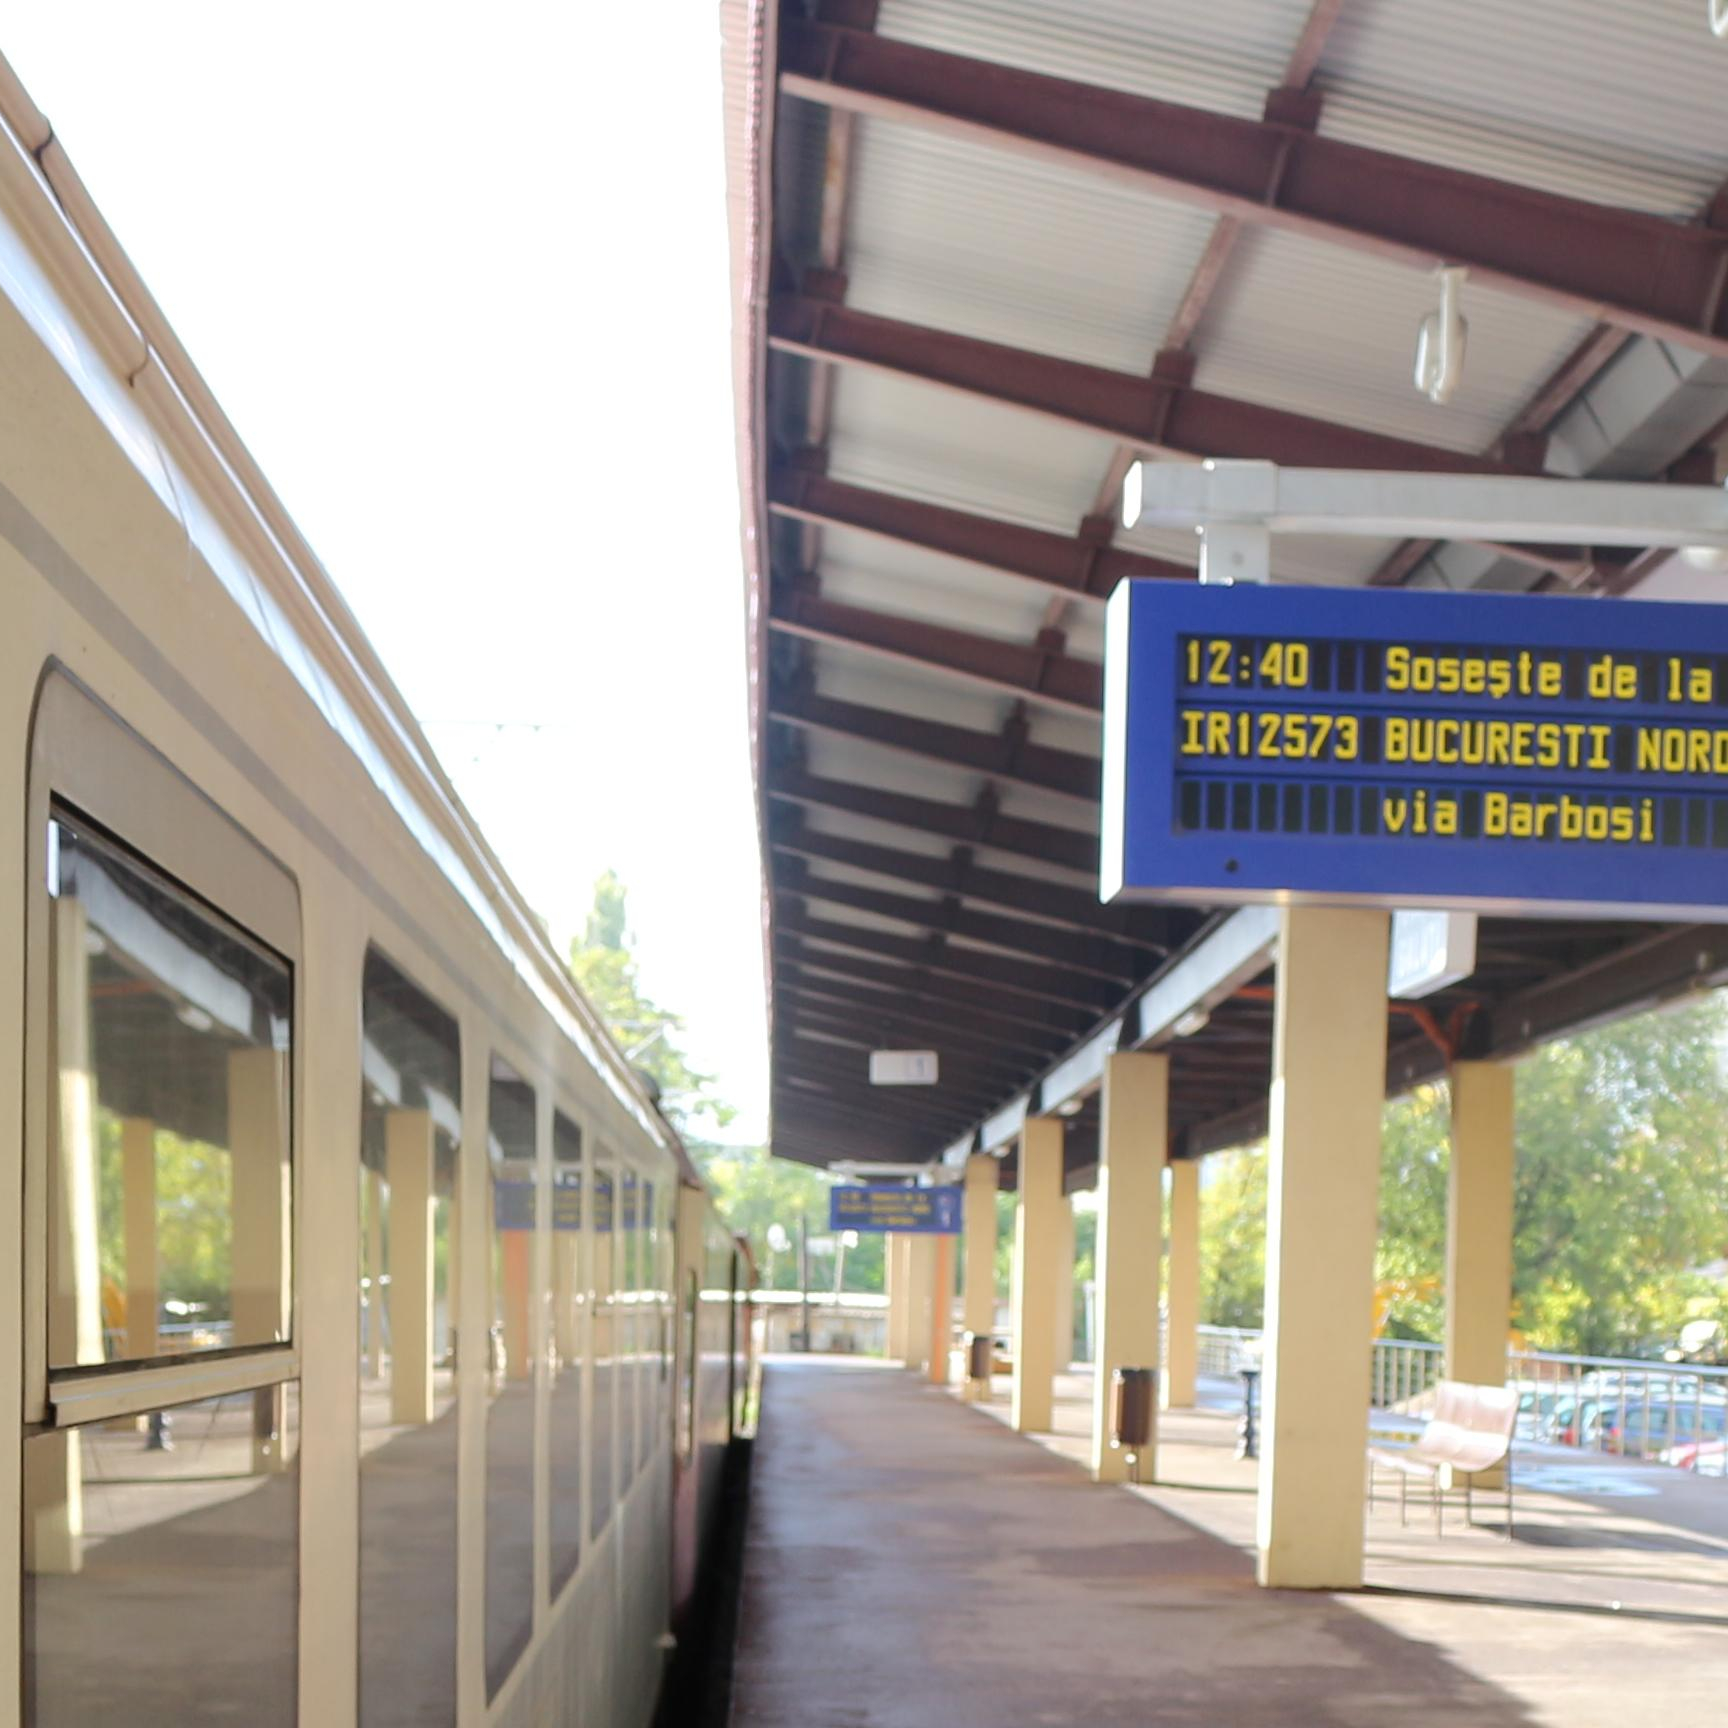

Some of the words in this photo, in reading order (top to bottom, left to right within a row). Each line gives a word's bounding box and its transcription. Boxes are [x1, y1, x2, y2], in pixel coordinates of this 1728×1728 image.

[1187, 640, 1308, 687] 12:40
[1588, 654, 1637, 698] de
[1668, 658, 1712, 702] la
[1181, 710, 1358, 758] IR12573
[1385, 717, 1611, 769] BUCURESTI
[1382, 790, 1457, 834] via
[1484, 792, 1653, 841] Barbosi
